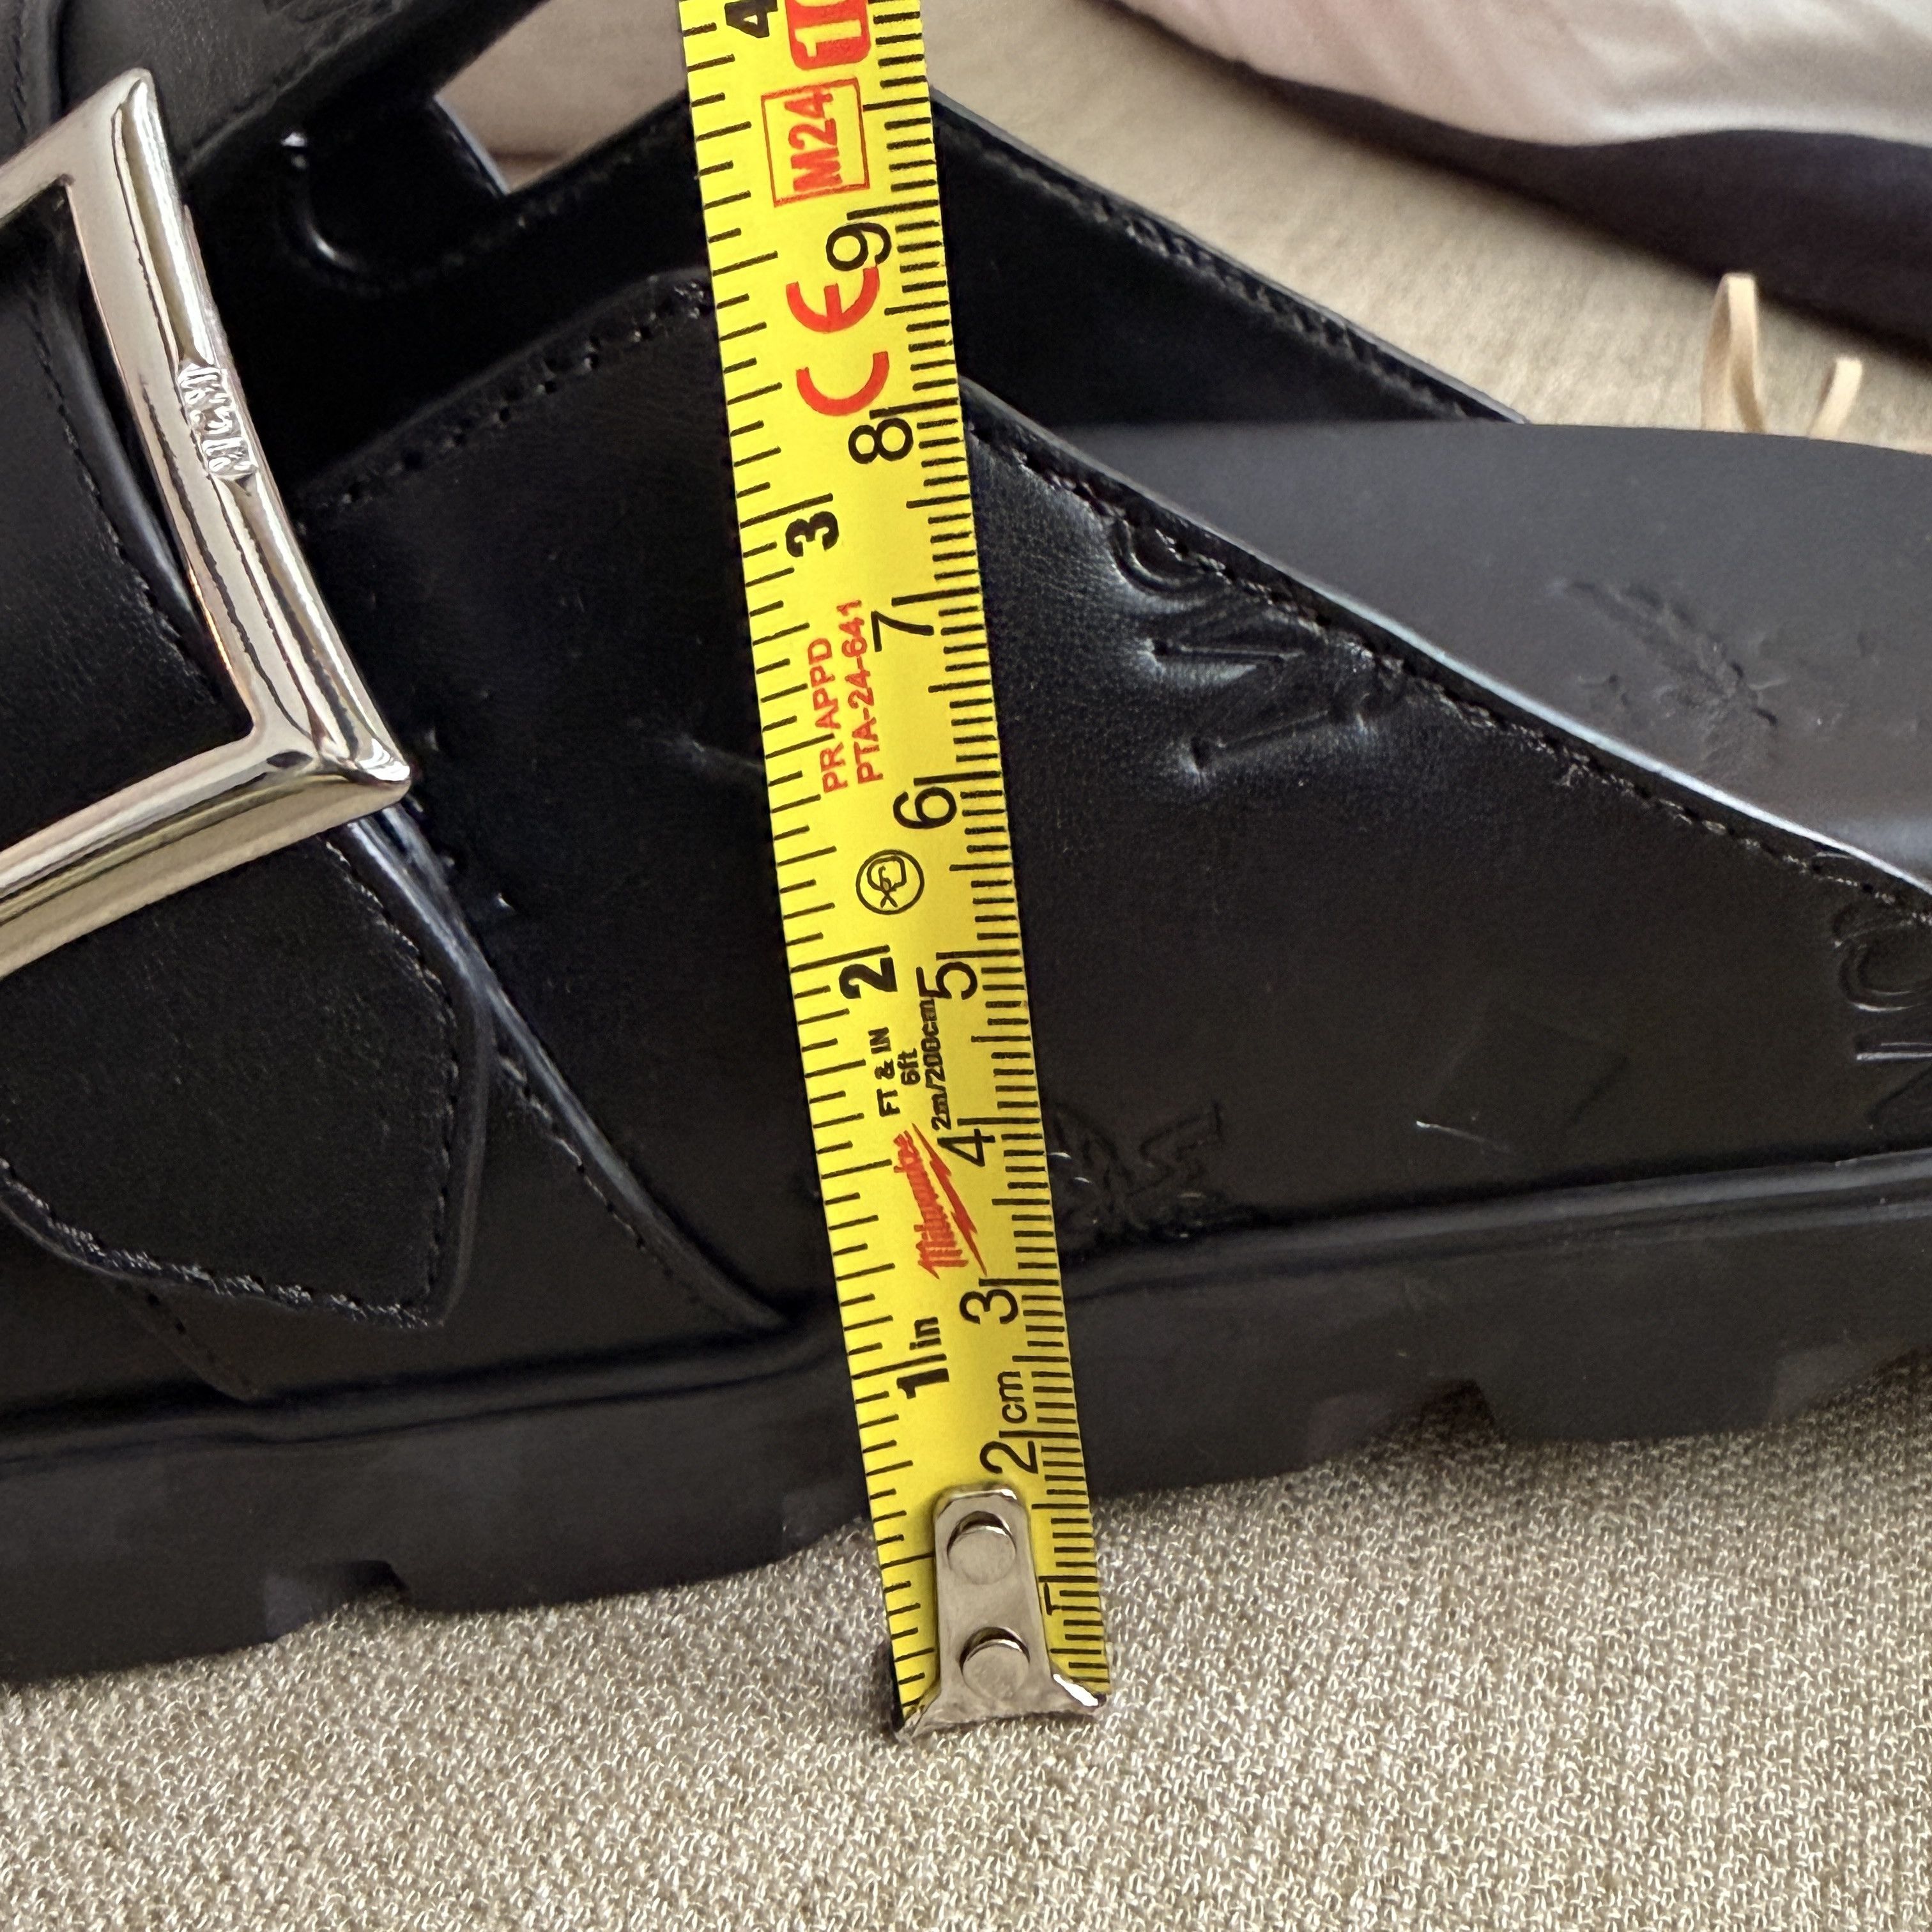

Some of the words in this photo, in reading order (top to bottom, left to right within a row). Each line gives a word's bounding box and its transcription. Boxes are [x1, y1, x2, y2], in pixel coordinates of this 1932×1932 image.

[724, 0, 778, 39] 4
[794, 0, 862, 58] 1
[783, 87, 843, 192] M24
[825, 222, 892, 272] 9
[786, 263, 890, 416] CE
[848, 417, 914, 464] 8
[785, 511, 839, 558] 3
[870, 611, 935, 652] 7
[808, 638, 840, 729] APPD
[836, 599, 884, 785] PTA-24-641
[820, 743, 848, 793] PR
[893, 786, 957, 829] 6
[838, 956, 898, 999] 2
[916, 961, 978, 1000] 5
[868, 1026, 892, 1054] IN
[896, 1047, 921, 1085] 6ft
[876, 1088, 901, 1117] FT
[937, 1128, 996, 1167] 4
[959, 1288, 1019, 1325] 3
[909, 1317, 941, 1350] in
[896, 1368, 949, 1399] 1
[997, 1371, 1028, 1424] cm
[979, 1440, 1039, 1475] 2
